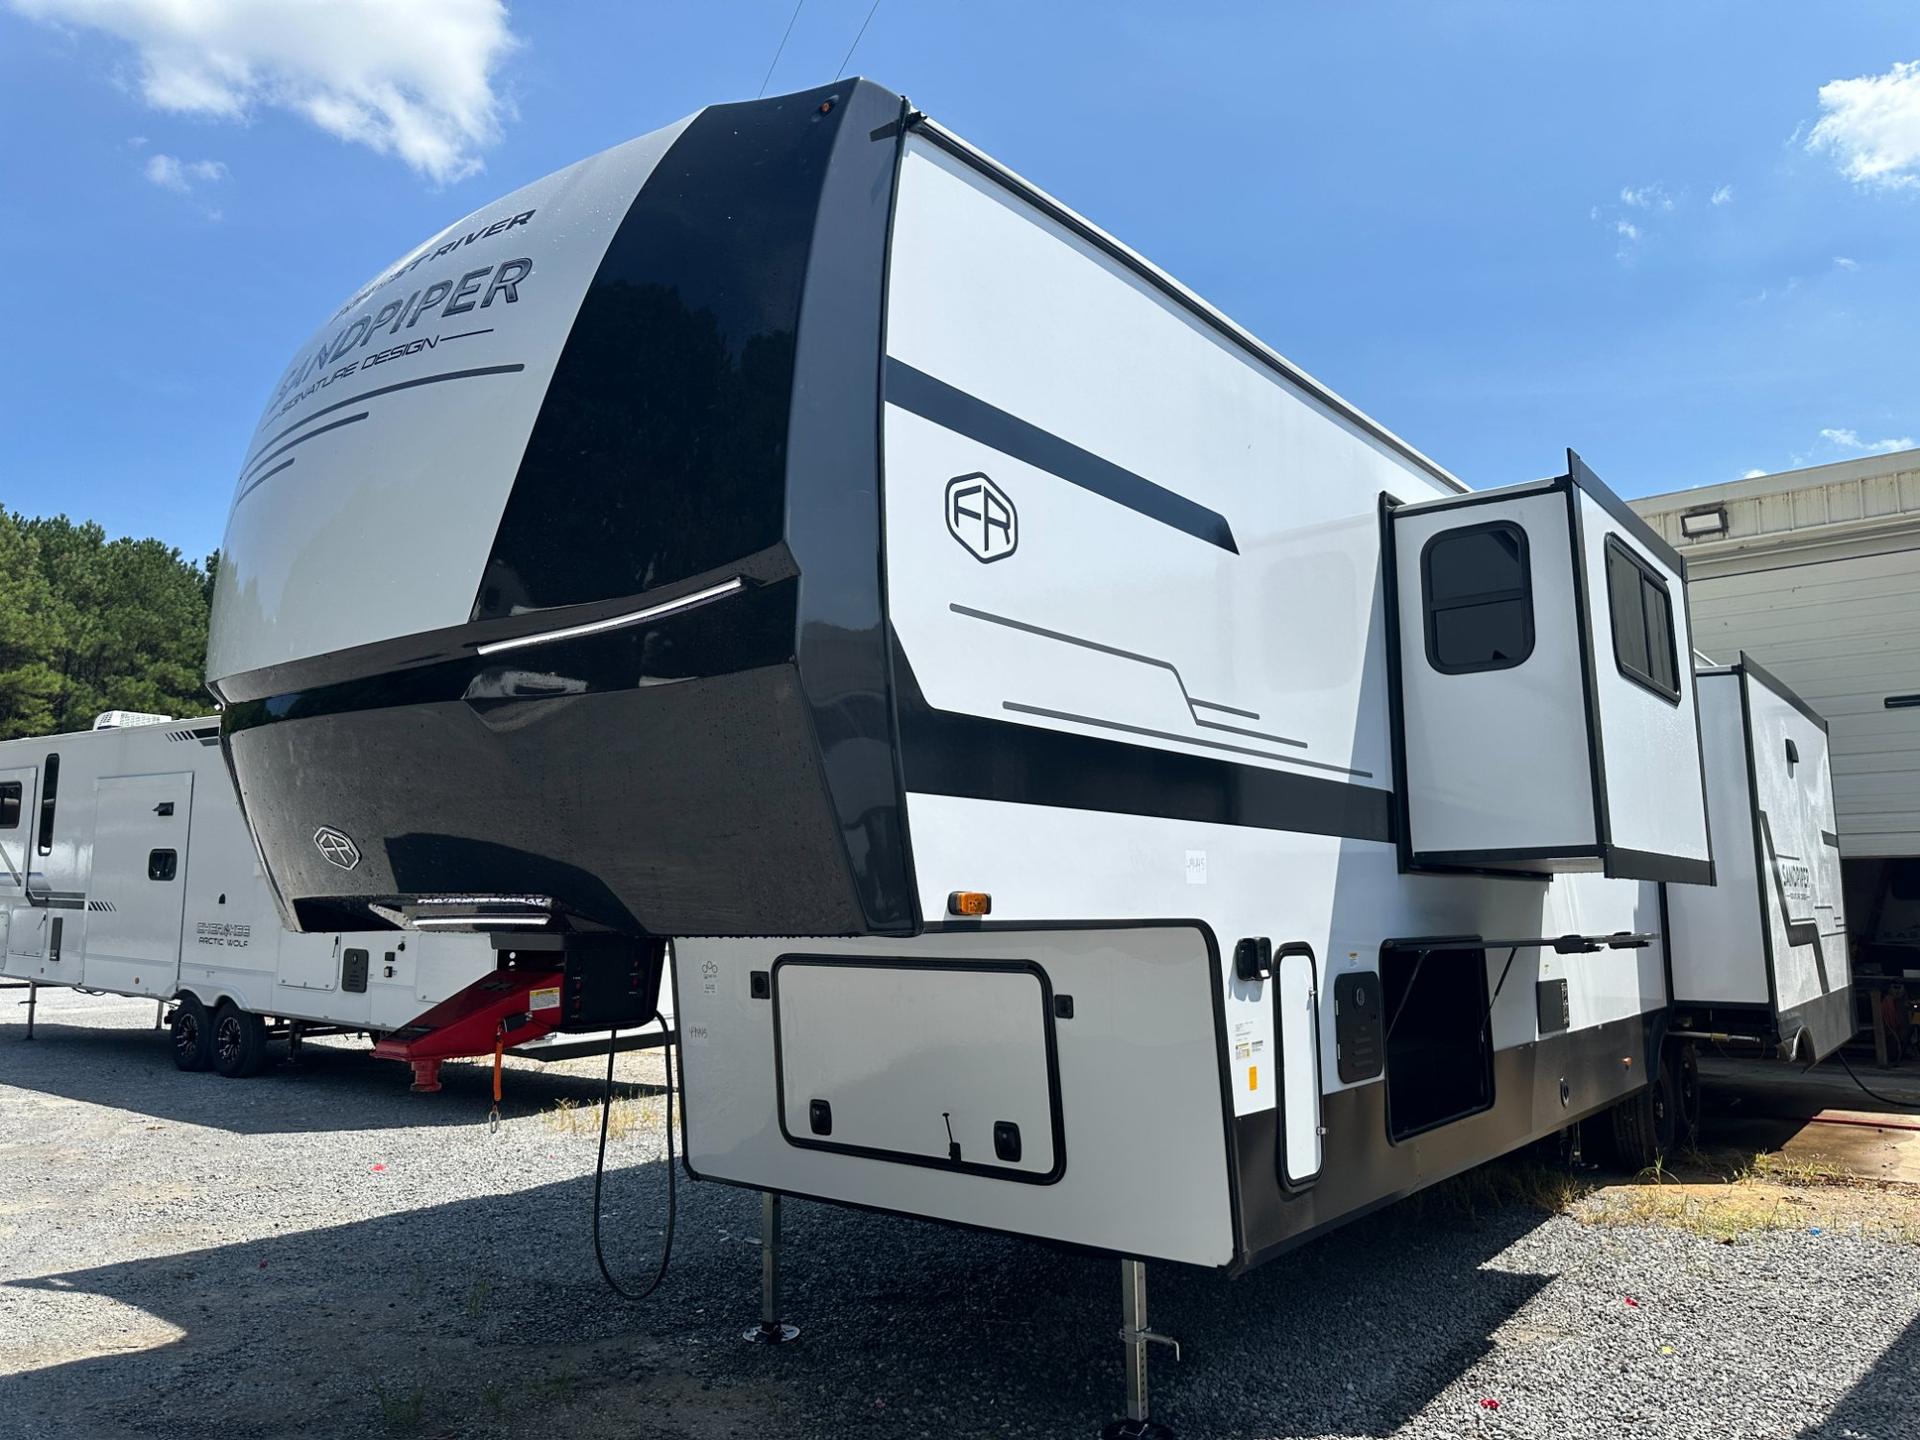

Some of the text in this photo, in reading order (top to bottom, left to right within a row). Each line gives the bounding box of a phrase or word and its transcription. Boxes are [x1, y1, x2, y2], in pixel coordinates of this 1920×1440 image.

[429, 209, 537, 262] RIVER
[361, 335, 441, 371] DESIGN
[198, 936, 248, 948] ARCTIC WOLF
